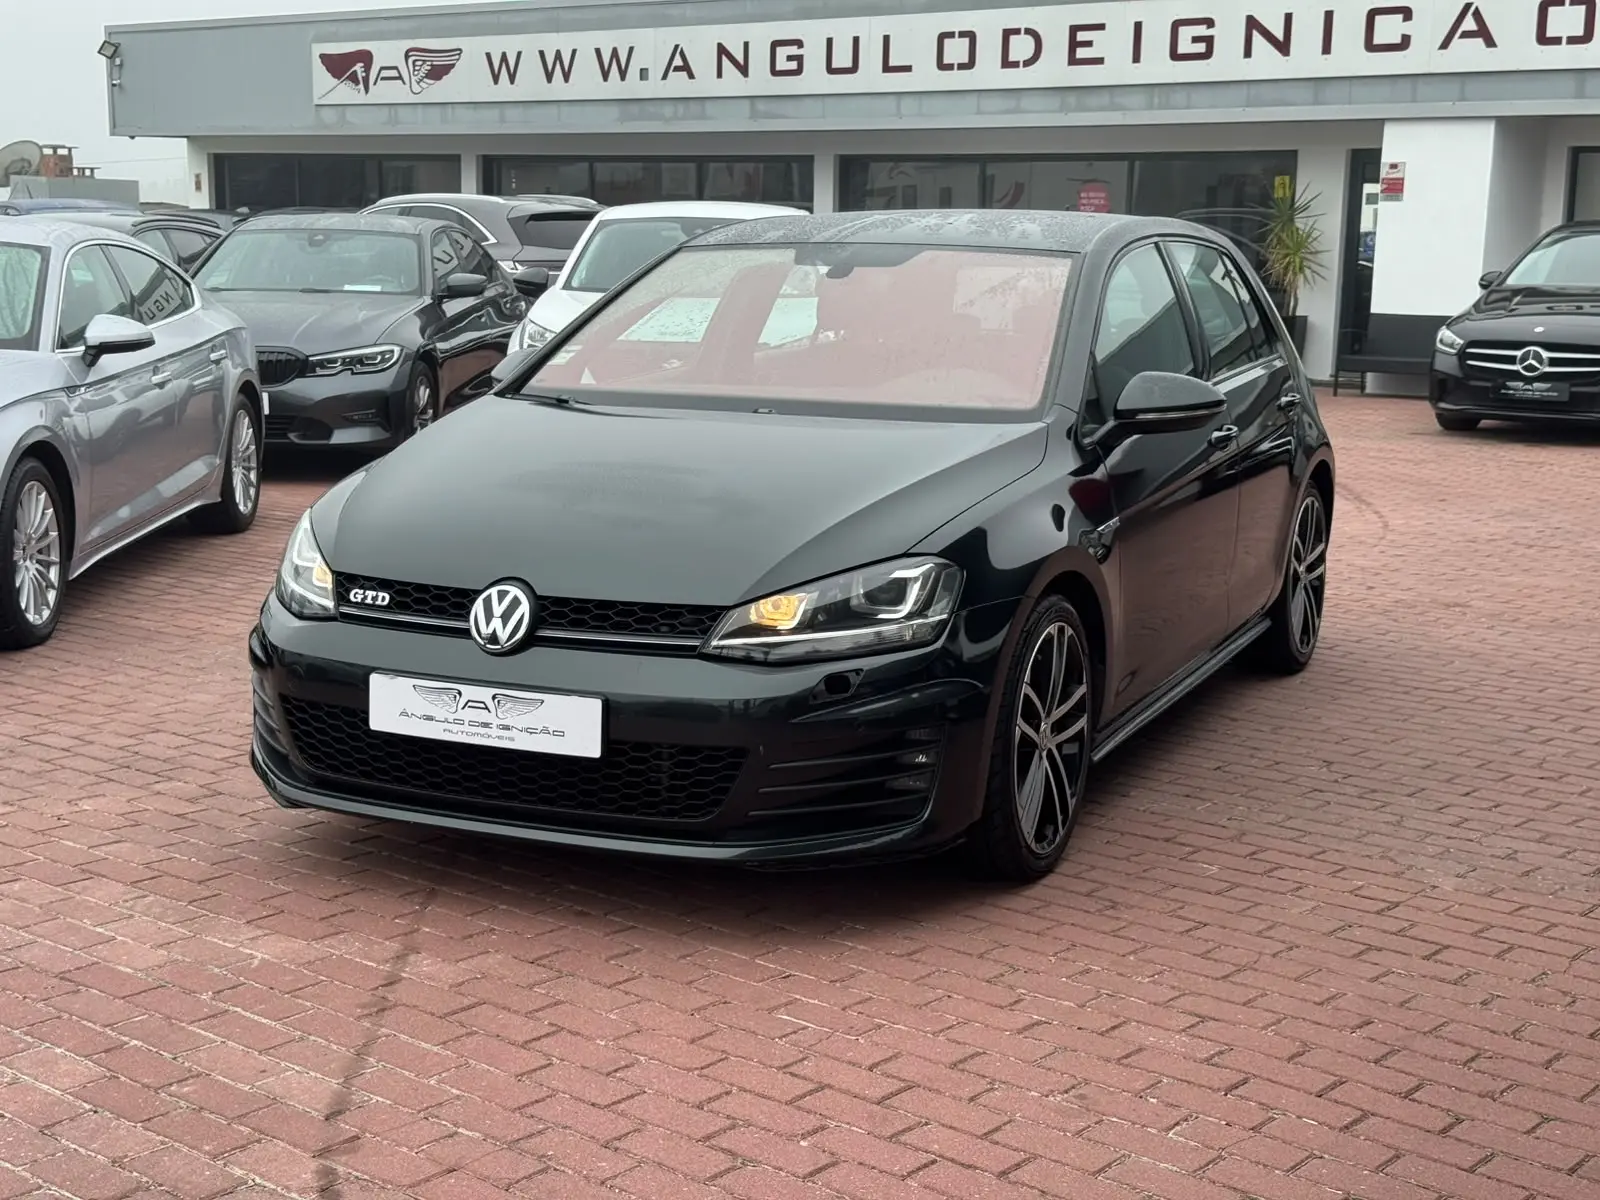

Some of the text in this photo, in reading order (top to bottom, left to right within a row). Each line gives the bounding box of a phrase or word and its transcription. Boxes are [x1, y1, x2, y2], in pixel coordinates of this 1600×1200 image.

[349, 588, 390, 606] GTD
[398, 708, 566, 738] ÂNGULO DE IGNIÇÃO
[443, 728, 516, 742] AUTOMÓVEIS
